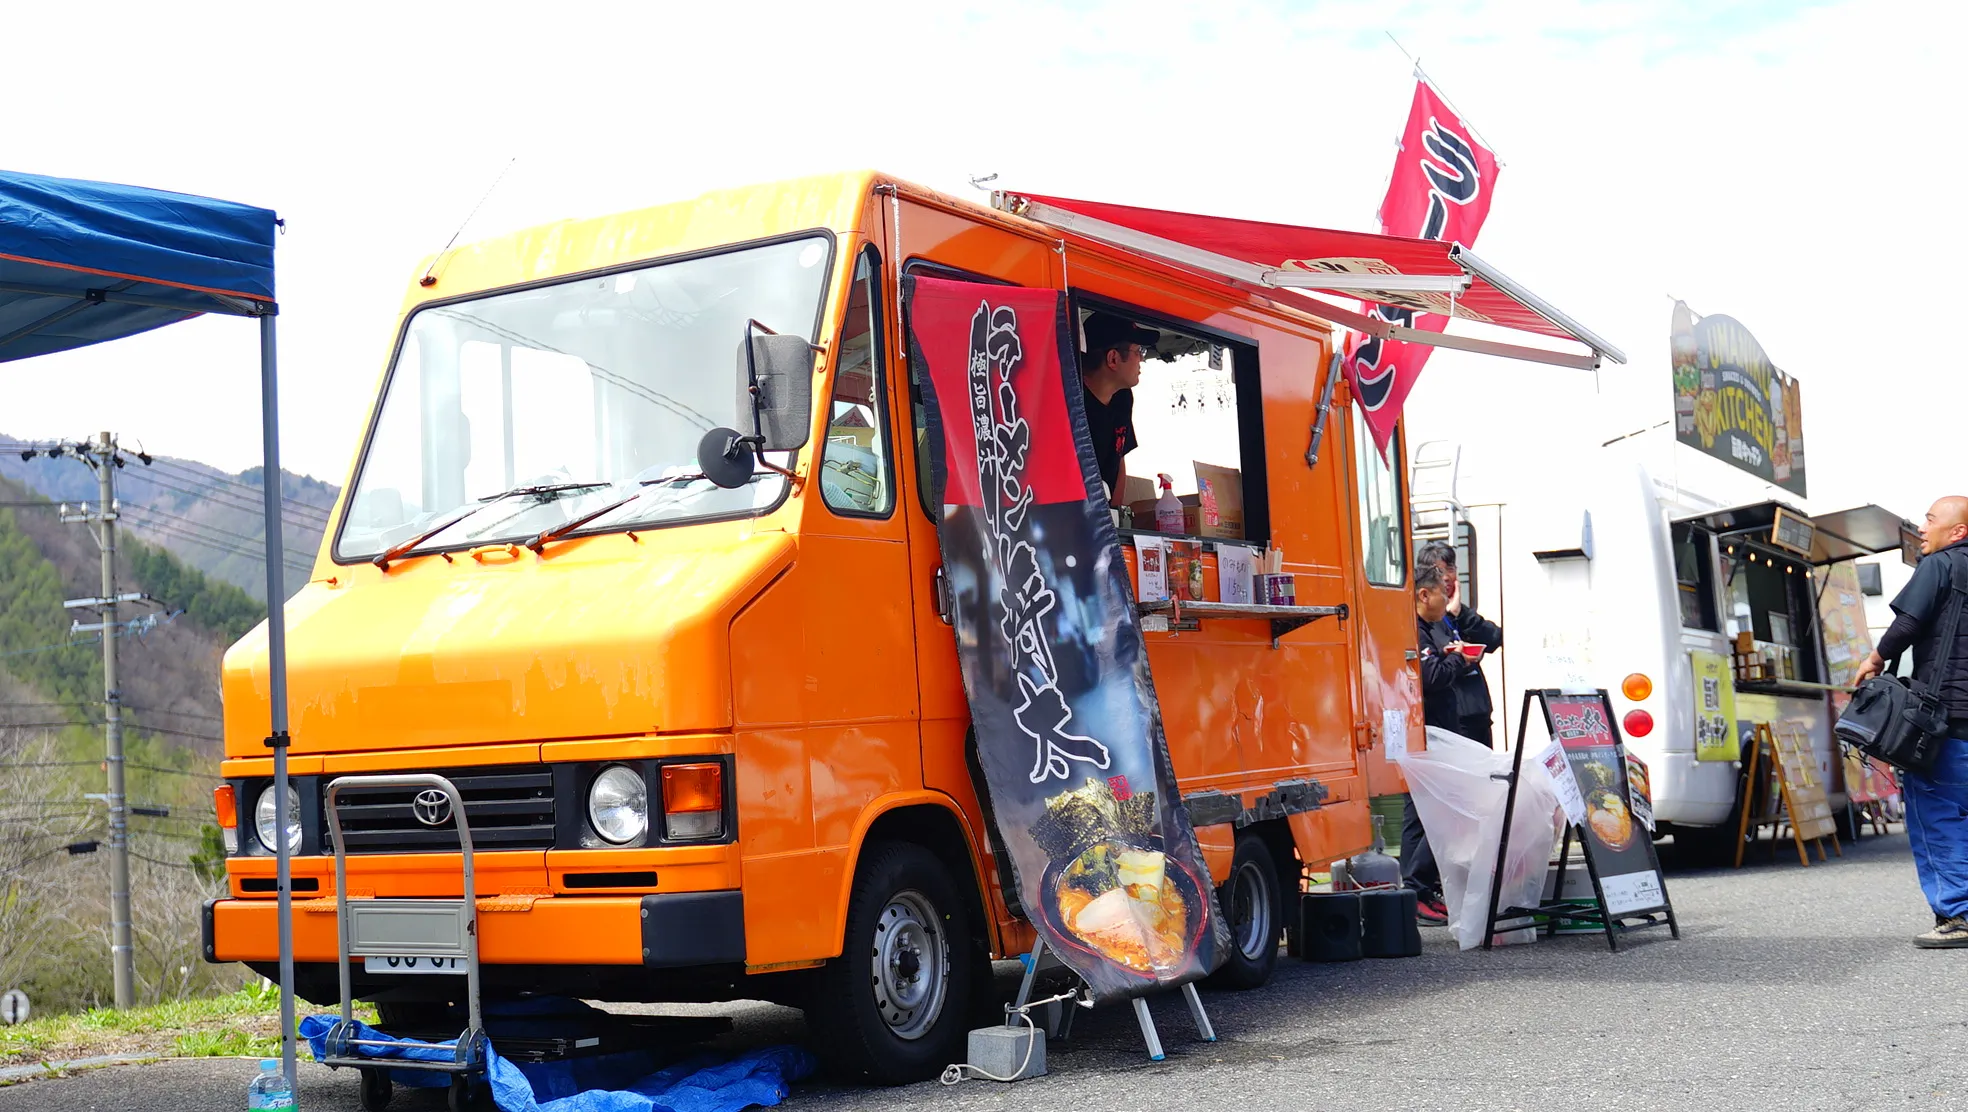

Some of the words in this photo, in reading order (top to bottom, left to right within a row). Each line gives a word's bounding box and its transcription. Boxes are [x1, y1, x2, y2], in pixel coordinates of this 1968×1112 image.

[970, 349, 996, 476] 極旨濃汁
[1716, 386, 1774, 461] KITCHEN
